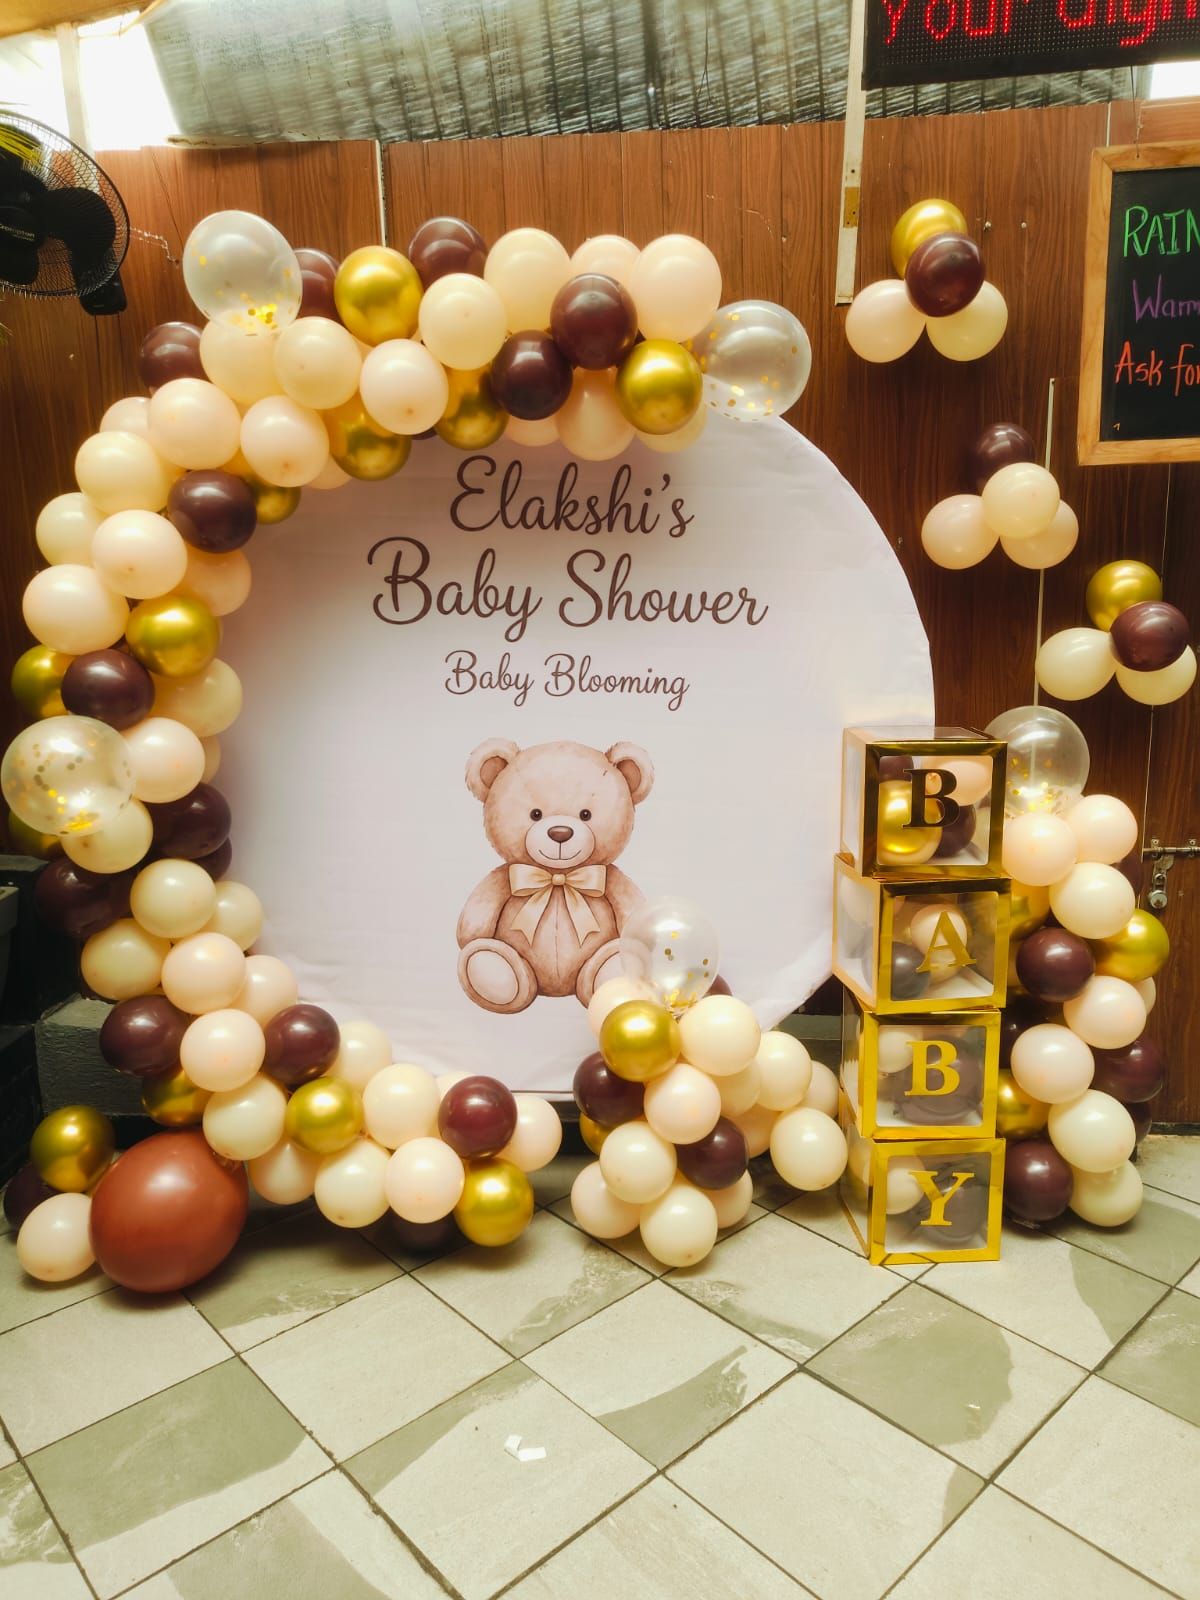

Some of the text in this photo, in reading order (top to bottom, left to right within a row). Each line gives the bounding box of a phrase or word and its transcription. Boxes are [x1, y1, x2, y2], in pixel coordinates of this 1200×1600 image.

[1114, 340, 1164, 386] Ask
[366, 536, 770, 644] Baby Shower
[444, 649, 691, 712] Baby Blooming
